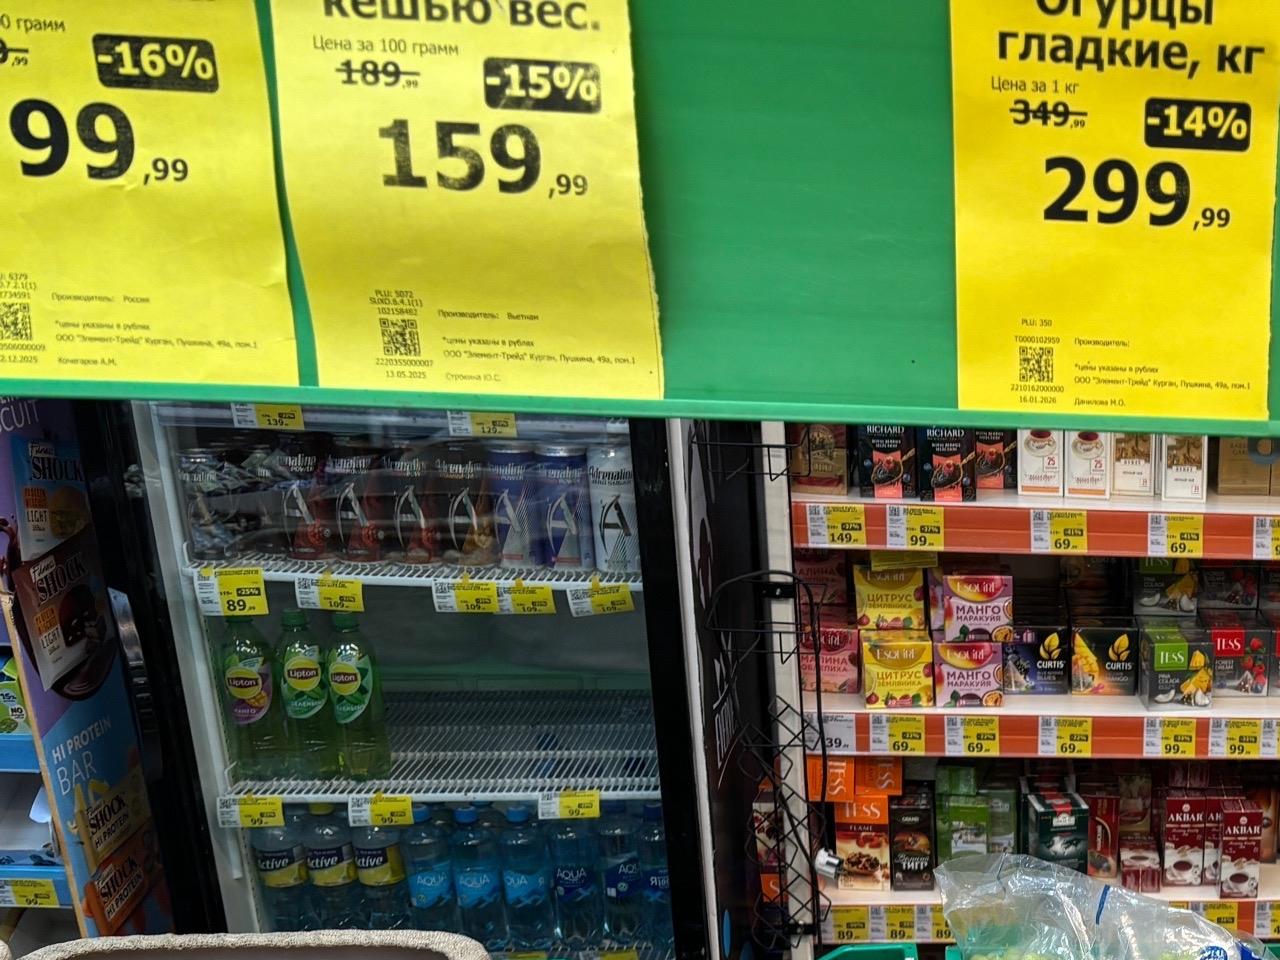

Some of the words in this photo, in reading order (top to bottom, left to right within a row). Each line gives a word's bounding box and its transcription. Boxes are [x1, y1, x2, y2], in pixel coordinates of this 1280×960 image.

[509, 0, 600, 30] вес.
[16, 18, 65, 32] грамм
[312, 35, 351, 53] Цена
[356, 40, 374, 52] за
[381, 39, 406, 53] 100
[411, 42, 459, 57] грамм
[97, 41, 214, 80] -16%
[998, 31, 1200, 79] гладкие,
[1217, 44, 1265, 74] кг
[485, 64, 598, 101] -15%
[991, 76, 1026, 92] Цена
[1032, 80, 1046, 93] за
[1053, 80, 1059, 93] 1
[1065, 81, 1079, 95] кг
[1147, 105, 1248, 141] -14%
[1039, 319, 1052, 327] 350
[1074, 337, 1130, 348] Производитель:
[1099, 365, 1127, 373] указаны
[1135, 365, 1159, 375] рублях
[1074, 376, 1090, 384] ООО
[1153, 380, 1179, 390] Курган,
[1181, 381, 1213, 390] Пушкина,
[867, 424, 904, 434] RICHARD
[926, 428, 965, 438] RICHARD
[1046, 456, 1056, 466] 25
[1094, 459, 1103, 468] 25
[31, 456, 86, 482] SHOCK
[36, 552, 86, 602] SHOCK
[867, 593, 912, 602] ЦИТРУС
[956, 605, 1001, 615] МАНГО
[956, 614, 1001, 622] МАРАКУЙЯ
[1216, 638, 1241, 650] TESS
[1160, 651, 1185, 664] TESS
[1036, 660, 1064, 669] CURTIS
[1105, 662, 1132, 670] CURTIS
[289, 669, 317, 678] Lipton
[332, 674, 355, 682] Lipton
[876, 671, 922, 680] ЦИТРУС
[946, 671, 991, 680] МАНГО
[228, 679, 256, 687] Lipton
[947, 679, 992, 688] МАРАКУЙЯ
[52, 746, 65, 764] HI
[68, 715, 113, 756] PROTEIN
[57, 751, 97, 796] BAR
[828, 760, 846, 796] TESS
[88, 793, 126, 836] SHOCK
[844, 803, 881, 818] TESS
[1168, 812, 1204, 822] AKBAR
[849, 824, 873, 832] FLAME
[1225, 825, 1261, 835] AKBAR
[99, 855, 139, 903] SHOCK
[556, 868, 587, 881] AQUA
